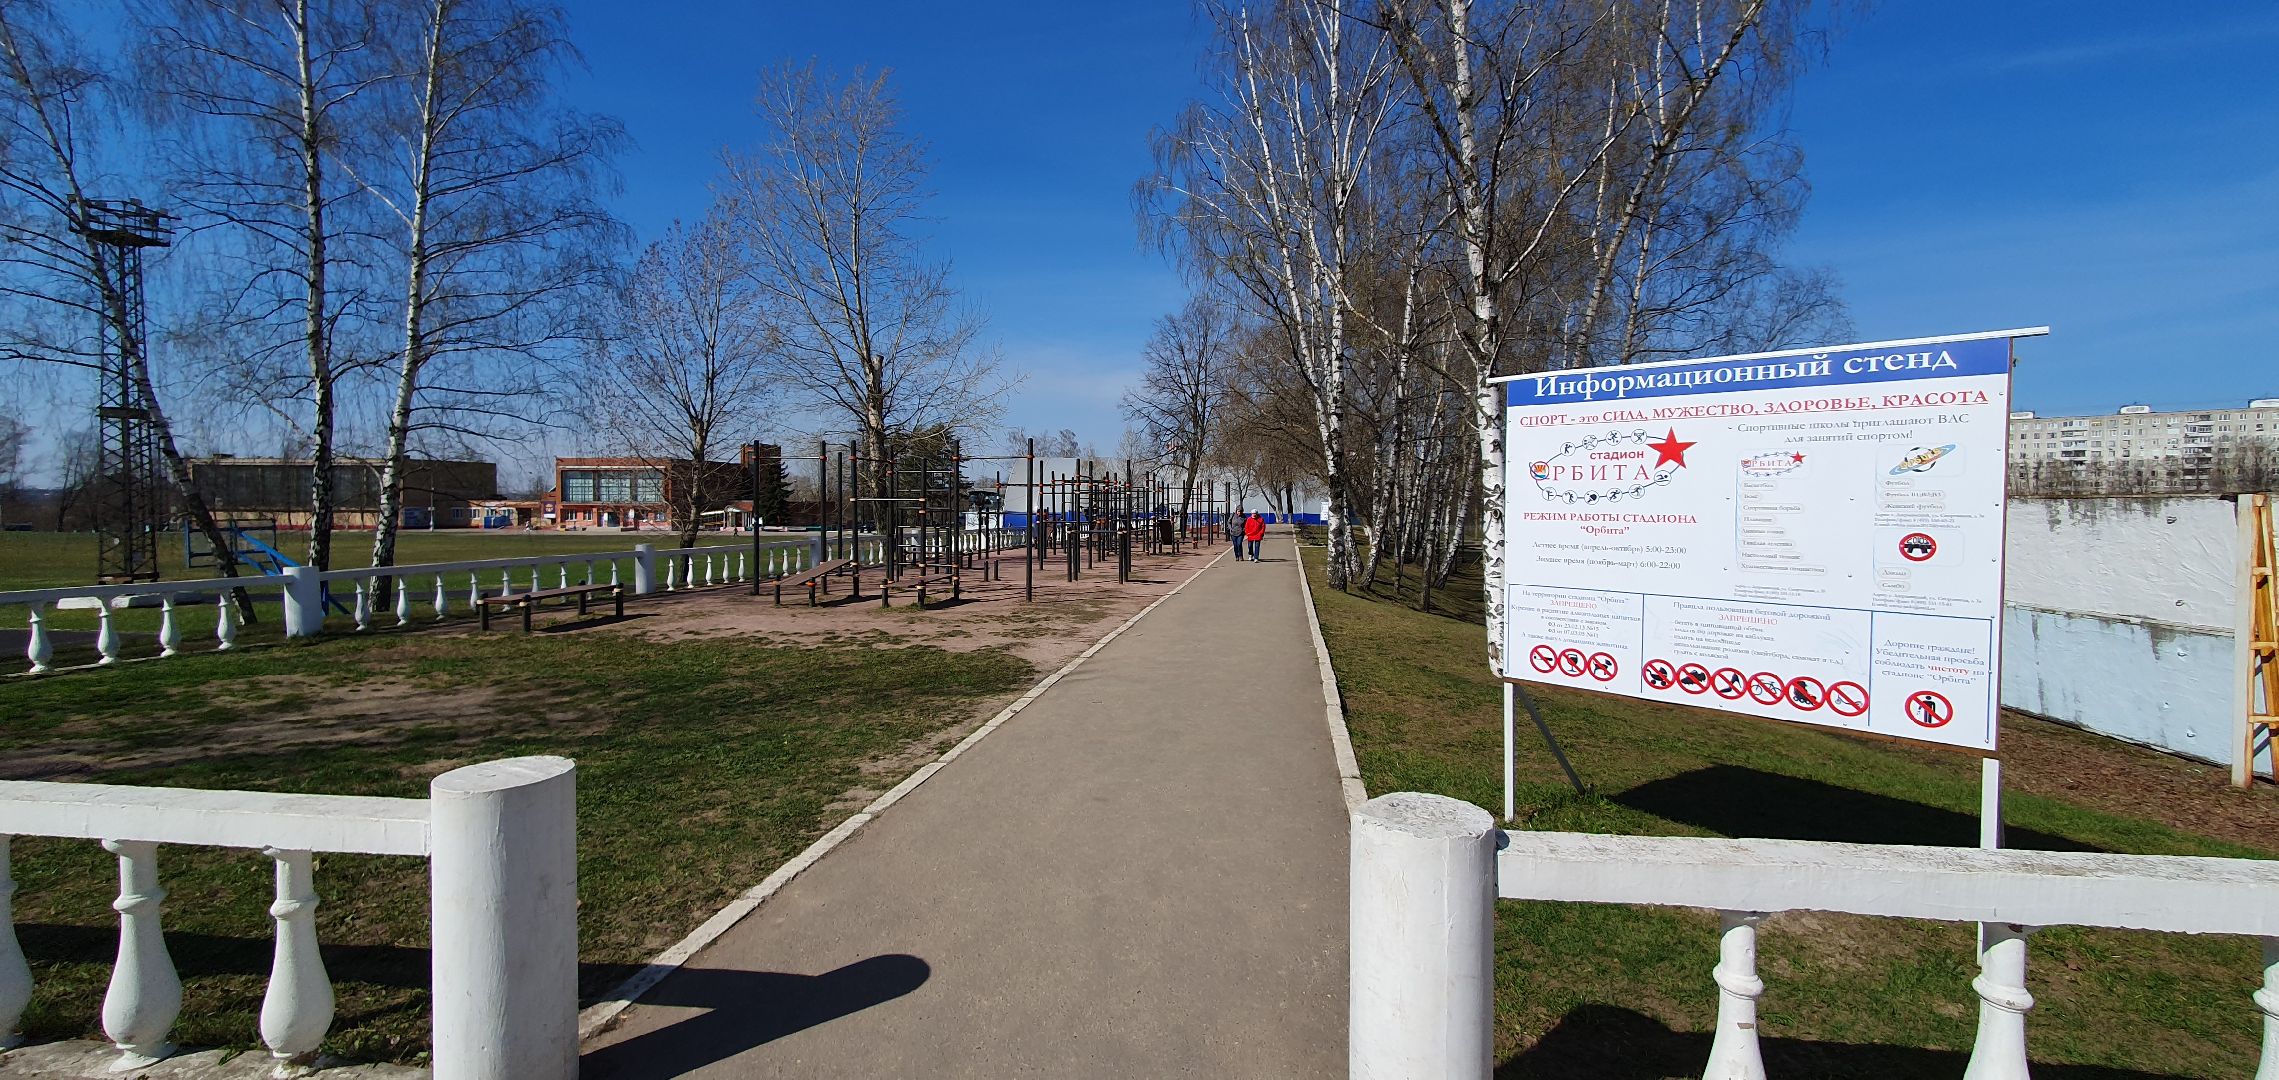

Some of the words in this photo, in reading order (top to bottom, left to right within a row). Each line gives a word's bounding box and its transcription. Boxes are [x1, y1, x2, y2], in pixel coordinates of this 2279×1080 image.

[1534, 353, 1832, 400] Информационный
[1843, 350, 1957, 374] стенд
[1519, 414, 1567, 427] СПОРТ
[1578, 414, 1599, 424] это
[1602, 409, 1648, 422] СИЛА,
[1652, 403, 1758, 419] МУЖЕСТВО,
[1763, 396, 1876, 415] ЗДОРОВЬЕ,
[1882, 390, 1988, 407] КРАСОТА
[1737, 422, 1806, 434] Спортивные
[1809, 421, 1849, 430] школы
[1853, 417, 1934, 430] приглашают
[1938, 413, 1970, 424] ВАС
[1785, 435, 1804, 444] для
[1807, 431, 1853, 442] занятий
[1856, 430, 1913, 444] спортом!
[1589, 450, 1645, 461] стадион
[1523, 512, 1566, 521] РЕЖИМ
[1570, 513, 1619, 522] РАБОТЫ
[1622, 513, 1697, 524] СТАДИОНА
[1640, 561, 1681, 570] 6:00-22:00
[1551, 599, 1598, 609] ЗАПРЕЩЕНО
[1719, 613, 1778, 626] ЗАПРЕЩЕНО
[1883, 639, 1925, 649] Дорогие
[1927, 645, 1976, 655] граждане!
[1875, 647, 1941, 662] Убедительная
[1943, 656, 1985, 666] просьба
[1874, 658, 1926, 670] соблюдать
[1927, 664, 1970, 676] чистоту
[1881, 669, 1925, 679] стадионе
